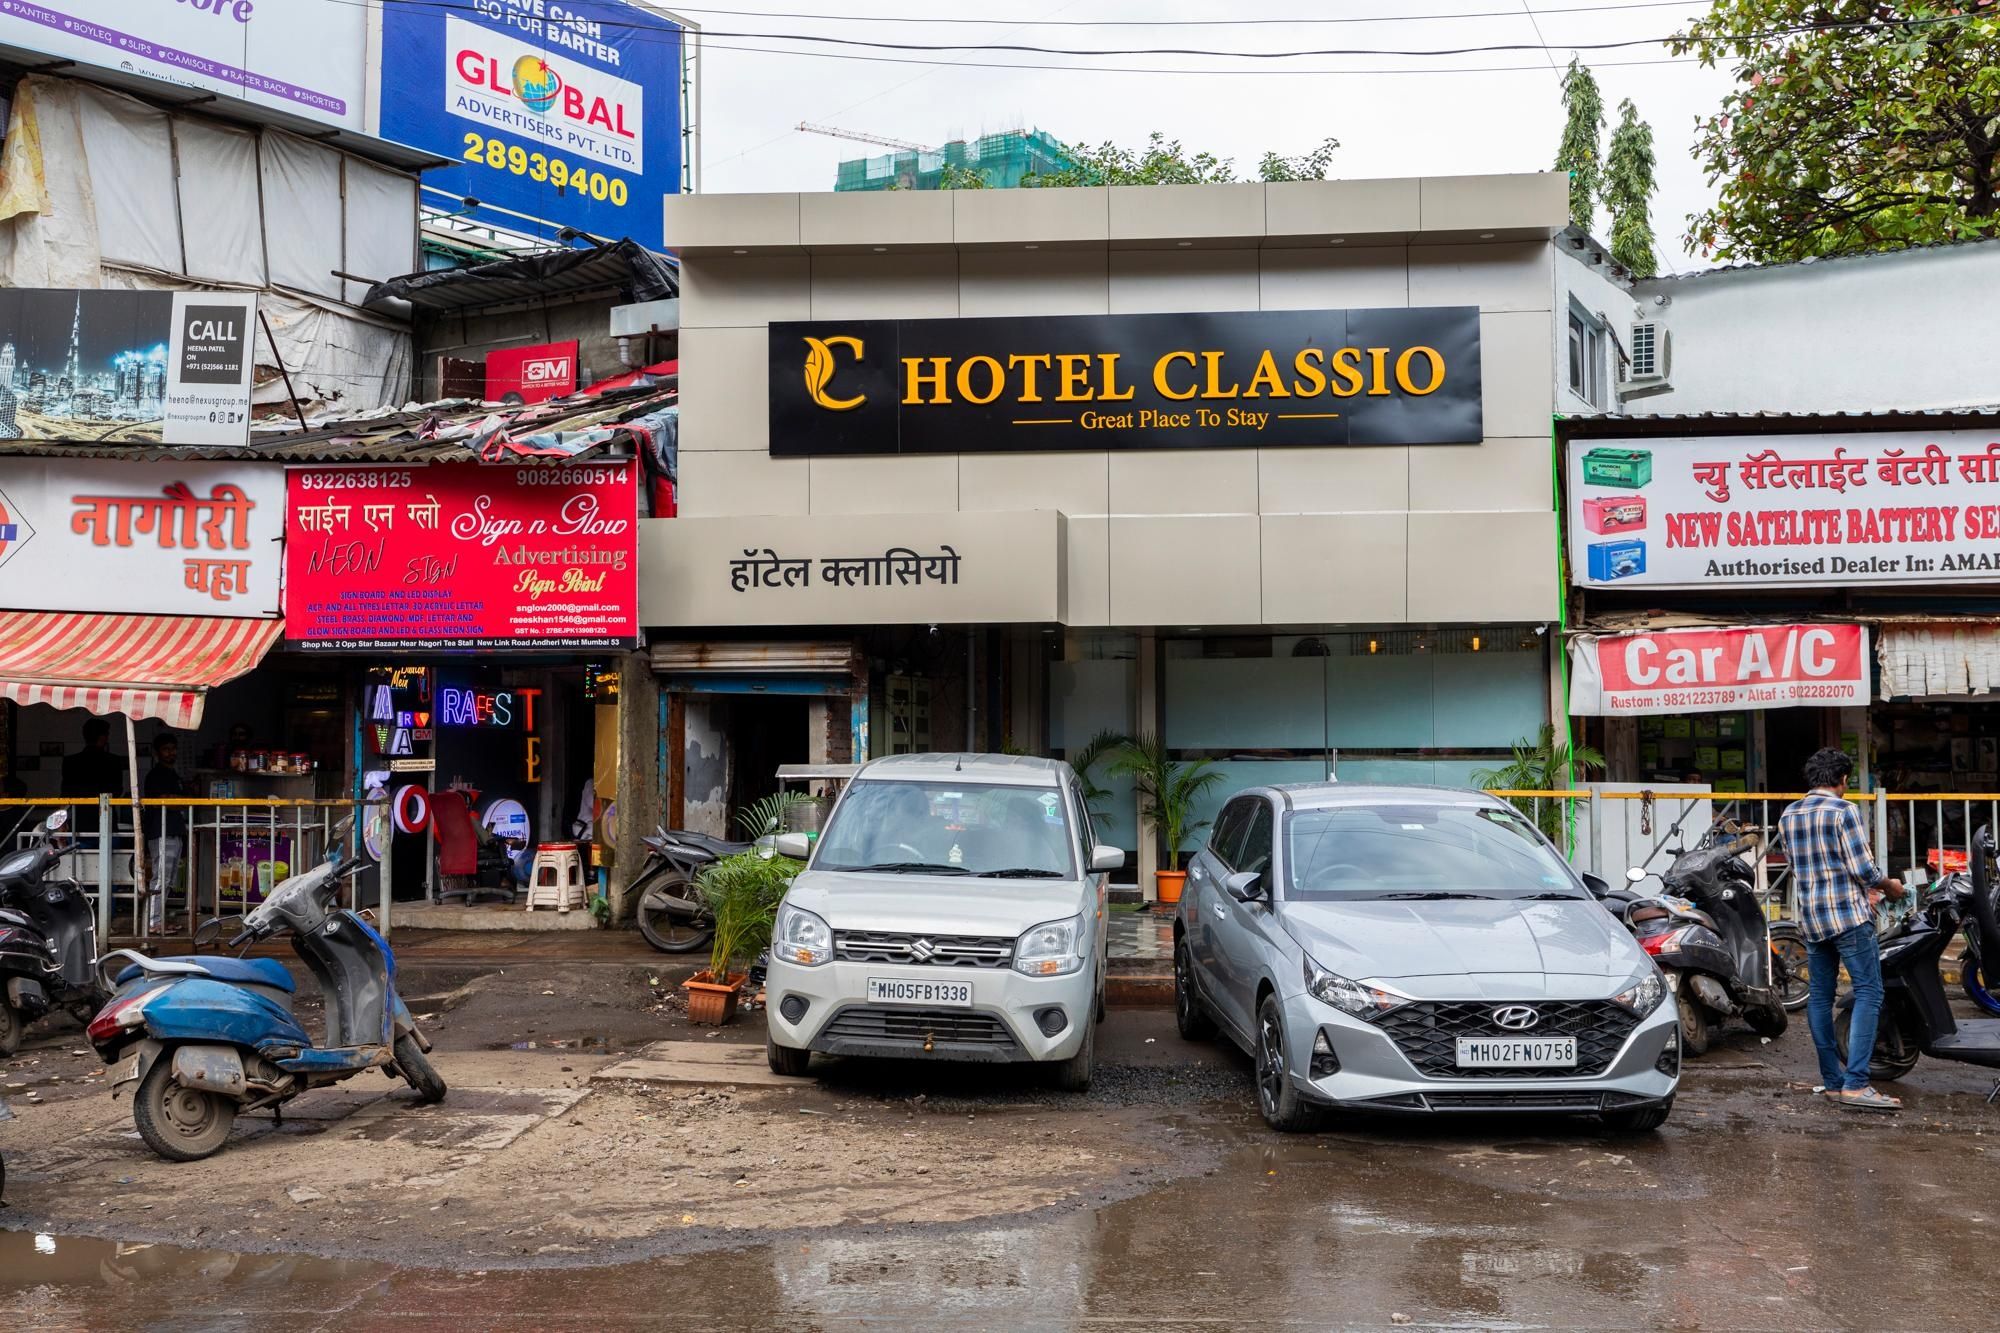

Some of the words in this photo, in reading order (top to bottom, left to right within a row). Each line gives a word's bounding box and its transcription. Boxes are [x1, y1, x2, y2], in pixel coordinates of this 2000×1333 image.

[474, 0, 502, 20] GO
[507, 8, 543, 37] FOR
[548, 24, 620, 66] BARTER
[550, 5, 601, 39] CASH
[13, 3, 57, 24] PANTIES
[73, 21, 113, 44] BOYLEG
[128, 39, 152, 54] SLIPS
[166, 51, 215, 73] CAMISOLE
[230, 70, 261, 87] RACER
[263, 80, 288, 94] BACK
[301, 92, 341, 110] SHORTIES
[456, 49, 635, 139] GLOBAL
[457, 95, 563, 141] ADVERTISERS
[568, 132, 599, 154] PVT.
[604, 144, 635, 165] LTD.
[463, 132, 628, 207] 28939400
[189, 320, 237, 341] CALL
[528, 360, 567, 380] GM
[901, 354, 1135, 405] HOTEL
[1153, 346, 1446, 400] CLASSIO
[169, 394, 248, 407] heena@nexusgroup.me
[1080, 411, 1133, 429] Great
[1139, 410, 1190, 428] Place
[1196, 409, 1221, 427] To
[1228, 408, 1269, 430] Stay
[302, 472, 411, 489] 9322638125
[517, 468, 628, 485] 9082660514
[1693, 462, 1731, 502] न्यु
[1877, 444, 1951, 486] बॅटरी
[71, 481, 256, 550] नागौरी
[298, 496, 352, 535] साईन
[363, 505, 395, 532] एन
[407, 494, 441, 529] ग्लो
[451, 495, 524, 546] Sign
[528, 519, 547, 535] n
[552, 493, 628, 535] Glow
[1666, 512, 1723, 549] NEW
[1727, 509, 1842, 547] SATELITE
[1847, 506, 1959, 545] BATTERY
[308, 537, 385, 575] NEON
[493, 545, 628, 571] Advertising
[730, 548, 812, 592] हॉटेल
[821, 545, 961, 587] क्लासियो
[1705, 558, 1824, 576] Authorised
[1830, 556, 1899, 574] Dealer
[1905, 555, 1934, 572] In:
[183, 558, 252, 601] चहा
[389, 591, 405, 599] AND
[407, 590, 420, 599] LED
[422, 590, 452, 598] DISPLAY
[513, 569, 556, 600] Sign
[558, 567, 606, 593] Point
[326, 603, 342, 611] AND
[344, 603, 356, 611] ALL
[359, 603, 380, 611] TYPES
[424, 602, 454, 610] ACRYLIC
[457, 614, 474, 622] AND
[510, 616, 626, 624] raeeskhan1546@gmail.com
[516, 604, 619, 613] snglow2000@gmail.com
[302, 641, 320, 649] Shop
[418, 640, 442, 648] Nagori
[307, 628, 329, 636] GLOW
[331, 627, 349, 635] SIGN
[350, 627, 375, 635] BOARD
[378, 627, 395, 635] AND
[419, 626, 441, 634] GLASS
[443, 626, 465, 634] NEON
[466, 626, 483, 634] SIGN
[1625, 638, 1722, 685] Car
[1736, 629, 1836, 680] A/C
[444, 689, 511, 726] RAEES
[1611, 696, 1653, 709] Rustom
[1664, 691, 1735, 706] 9821223789
[1748, 688, 1776, 702] Altaf
[878, 983, 968, 1001] MH05FB1338
[1471, 1044, 1572, 1061] MH02FN0758
